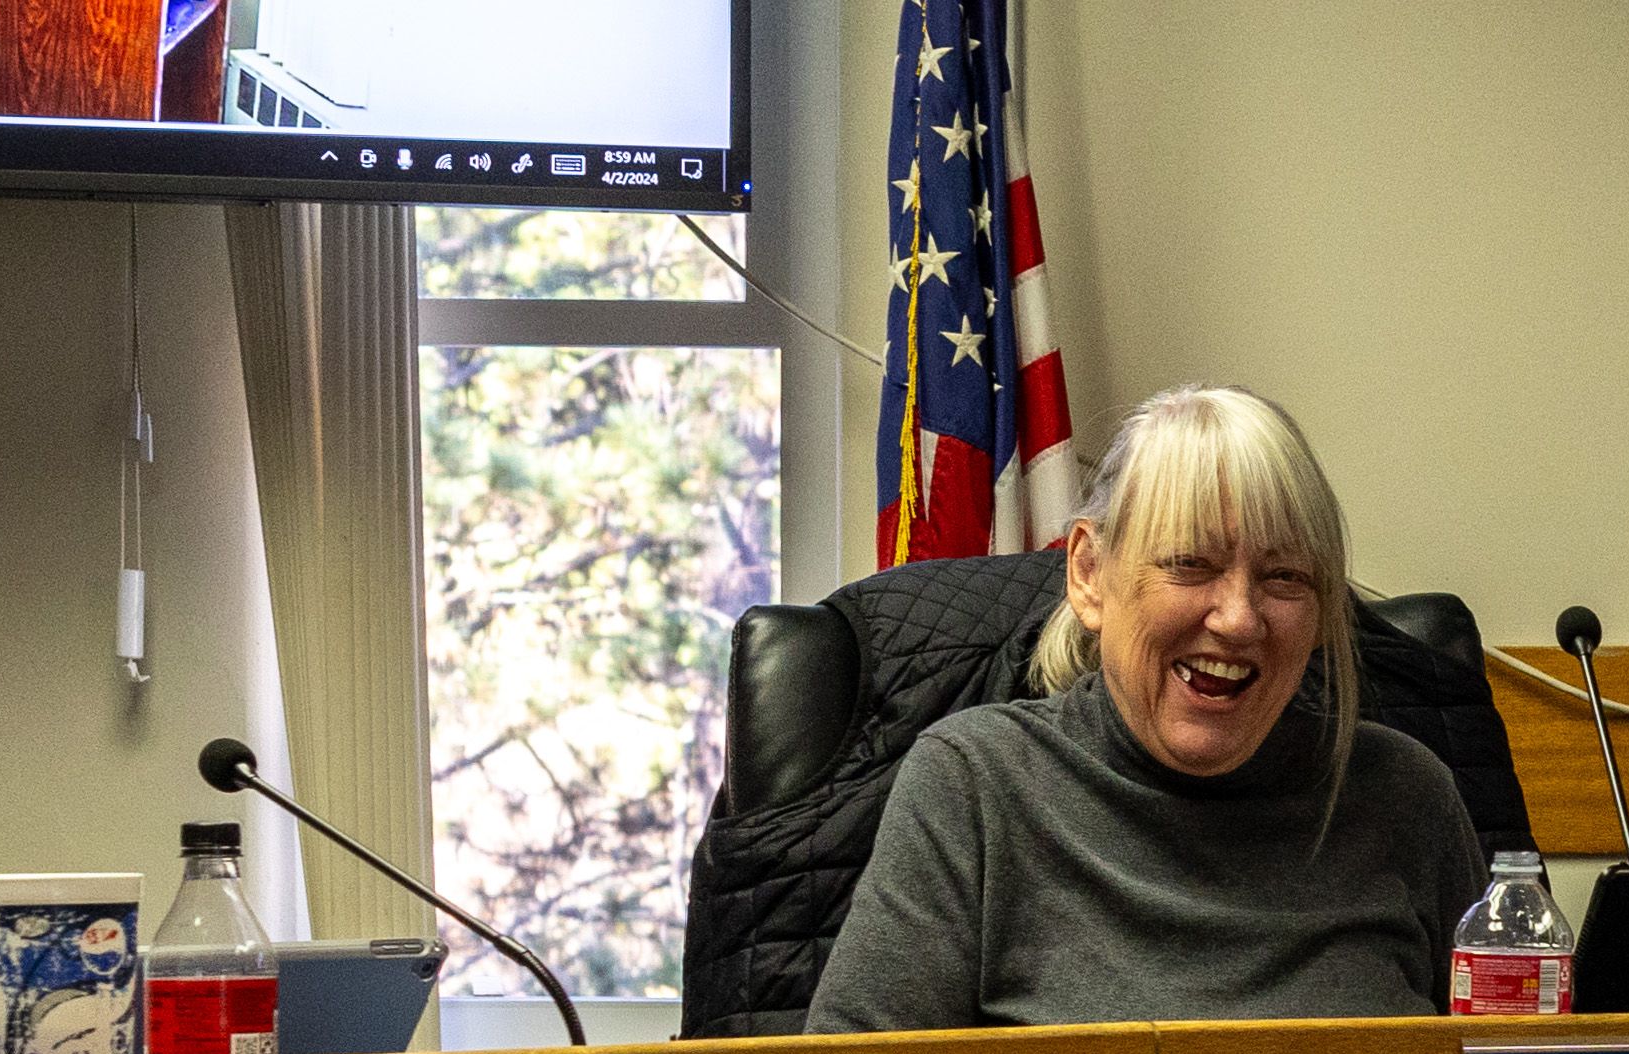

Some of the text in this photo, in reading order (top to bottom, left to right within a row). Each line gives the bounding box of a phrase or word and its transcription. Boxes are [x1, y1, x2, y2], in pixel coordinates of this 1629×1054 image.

[604, 150, 656, 164] 8:59 AM
[601, 171, 659, 185] 4/2/2024
